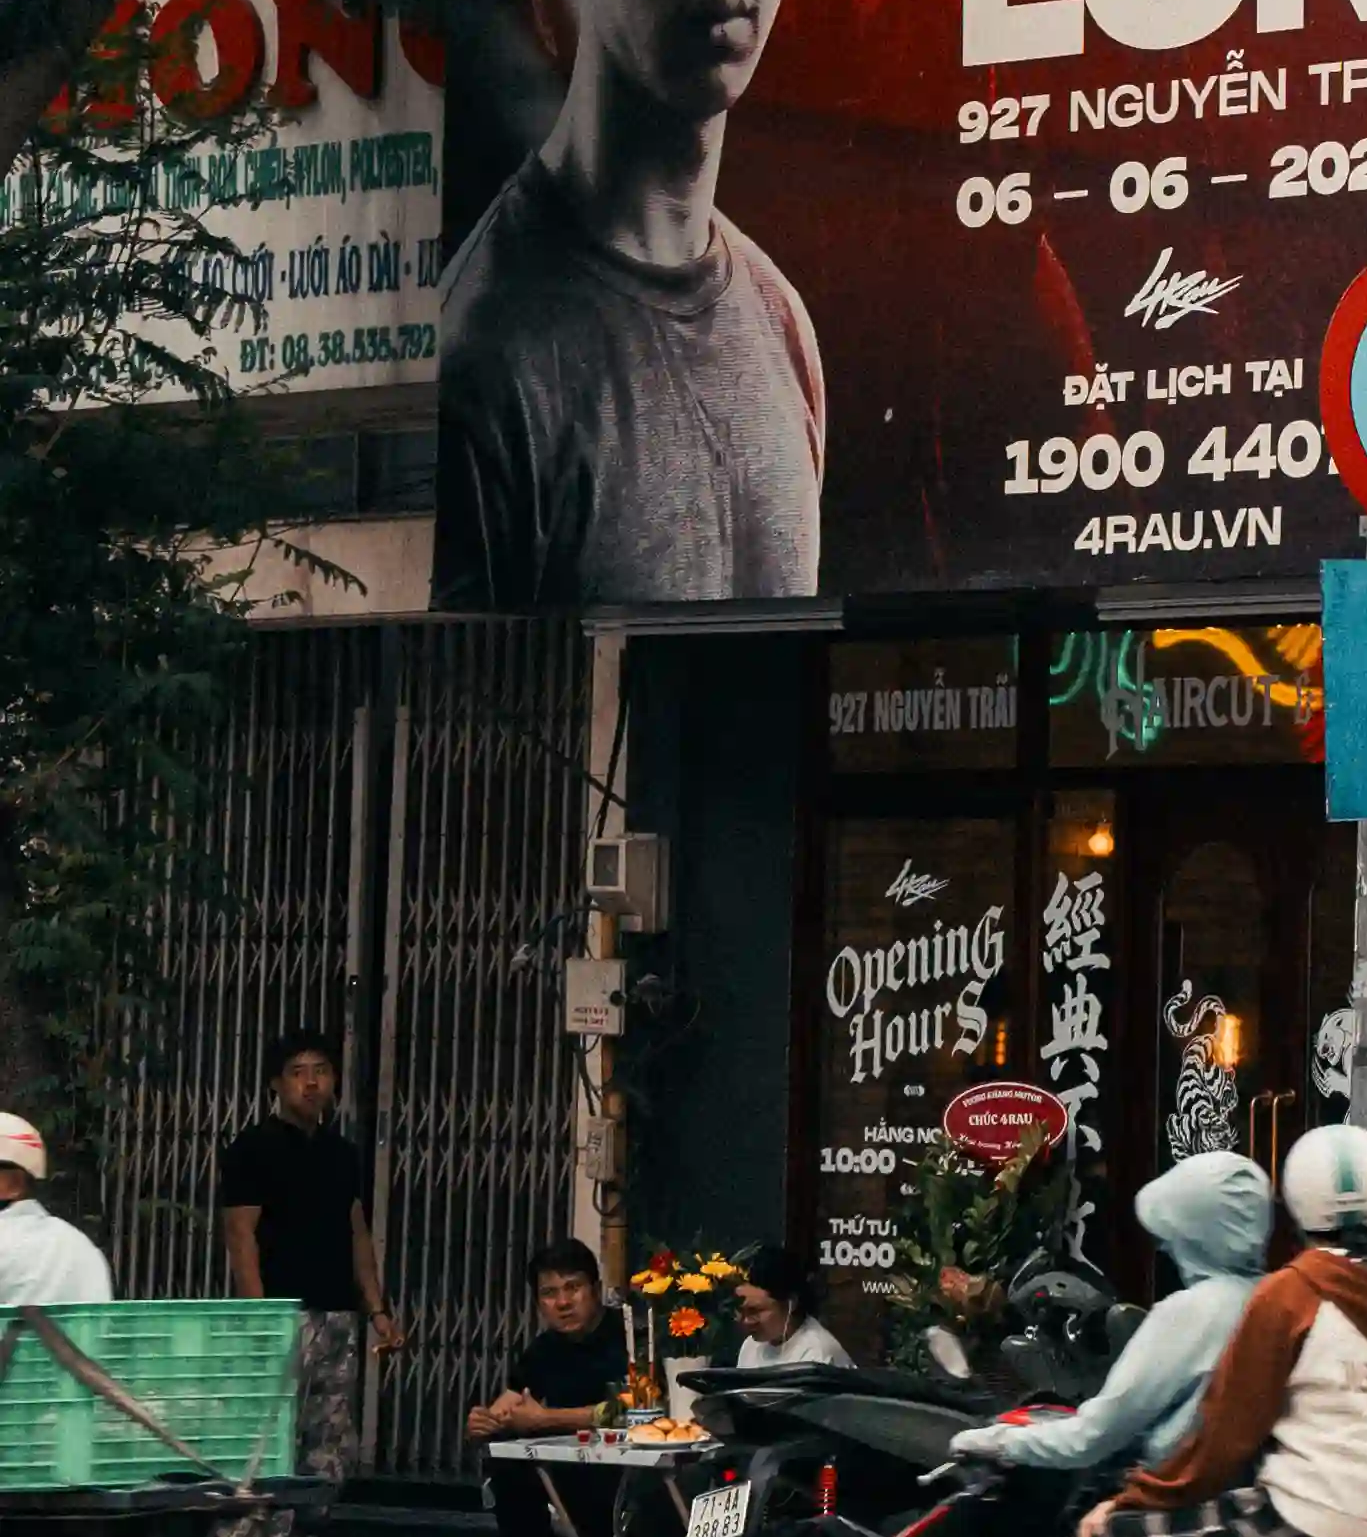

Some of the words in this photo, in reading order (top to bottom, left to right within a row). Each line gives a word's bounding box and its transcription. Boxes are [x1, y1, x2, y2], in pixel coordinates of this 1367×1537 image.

[957, 93, 1051, 144] 927
[1069, 48, 1288, 133] NGUYỄN
[956, 172, 1033, 228] 06
[1109, 157, 1190, 214] 06
[288, 234, 330, 300] LƯỚI
[335, 234, 362, 295] ÁO
[367, 229, 401, 293] DÀI
[240, 338, 275, 373] ĐT:
[1063, 363, 1134, 412] ĐẶT
[1146, 362, 1232, 405] LỊCH
[1245, 359, 1304, 399] TẠI
[1004, 429, 1165, 496] 1900
[1187, 418, 1339, 482] 440
[1074, 505, 1283, 557] 4RAU.VN
[829, 691, 868, 736] 927
[873, 666, 962, 733] NGUYỄN
[966, 672, 1018, 729] TRÃI
[819, 1146, 897, 1175] 10:00
[828, 1213, 866, 1237] THỨ
[819, 1239, 897, 1269] 10:00
